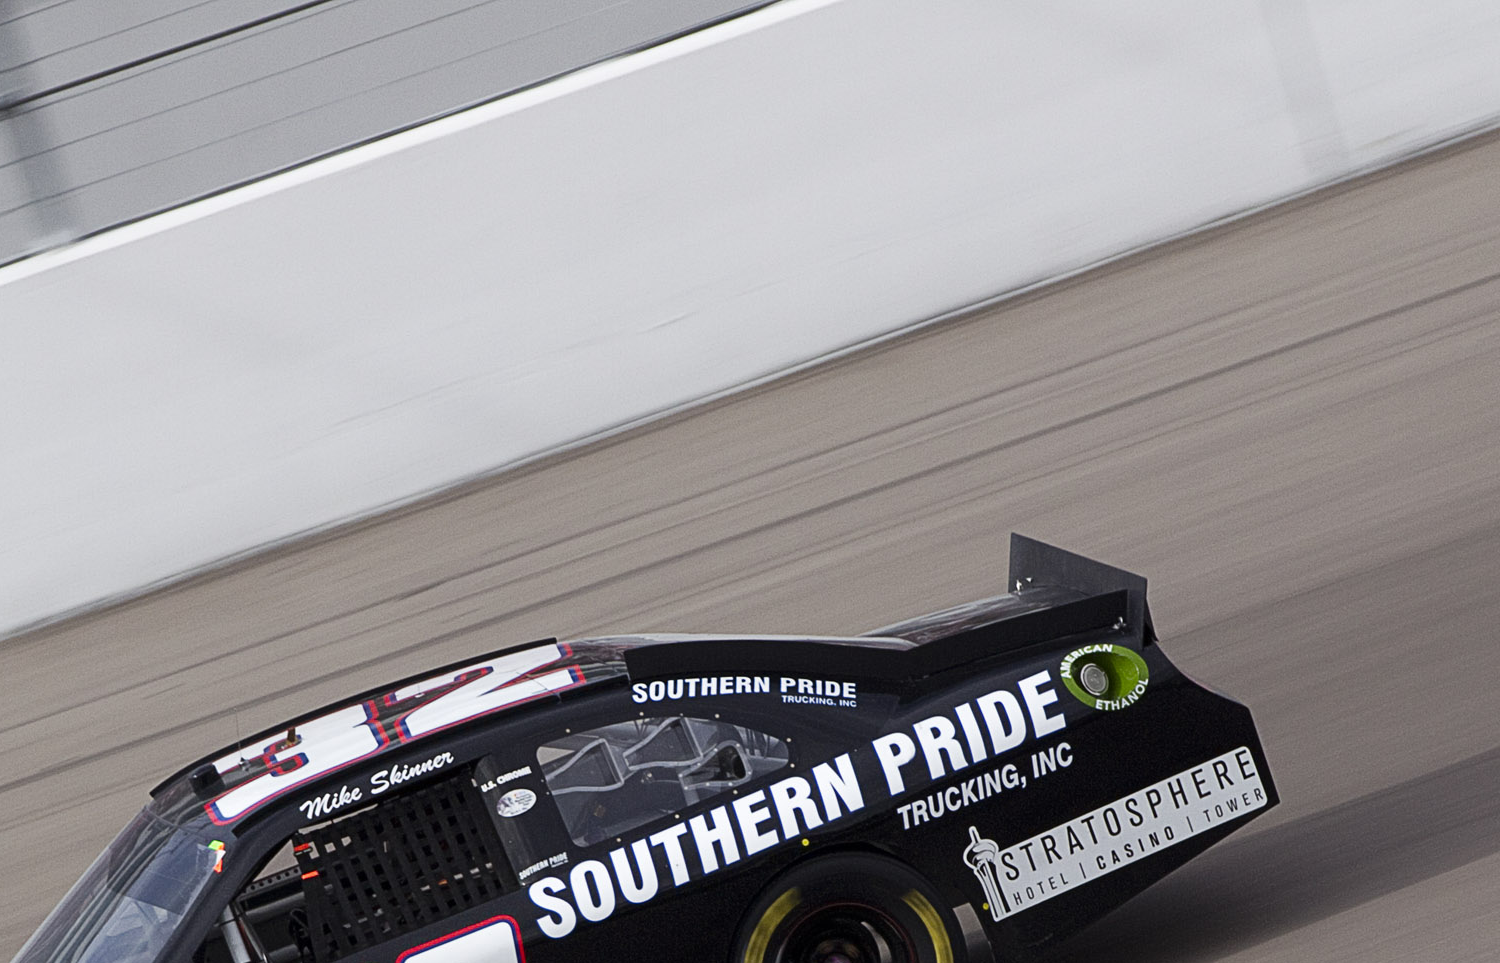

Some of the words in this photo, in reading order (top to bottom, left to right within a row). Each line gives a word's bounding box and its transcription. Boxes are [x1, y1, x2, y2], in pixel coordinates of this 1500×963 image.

[631, 676, 770, 704] SOUTHERN
[779, 677, 857, 699] PRIDE
[839, 699, 857, 708] INC
[1060, 644, 1113, 679] AMERICAN
[1095, 679, 1148, 711] ETHANOL
[204, 642, 586, 826] 32
[299, 785, 363, 820] Mike
[370, 752, 454, 795] Skinner
[528, 753, 865, 939] SOUTHERN
[871, 669, 1067, 797] PRIDE
[897, 763, 1027, 831] TRUCKING,
[1030, 742, 1074, 780] INC
[1000, 750, 1255, 881] STRATOSPHERE
[1013, 873, 1069, 906] HOTEL
[1096, 826, 1175, 871] CASINO
[1203, 788, 1264, 822] TOWER
